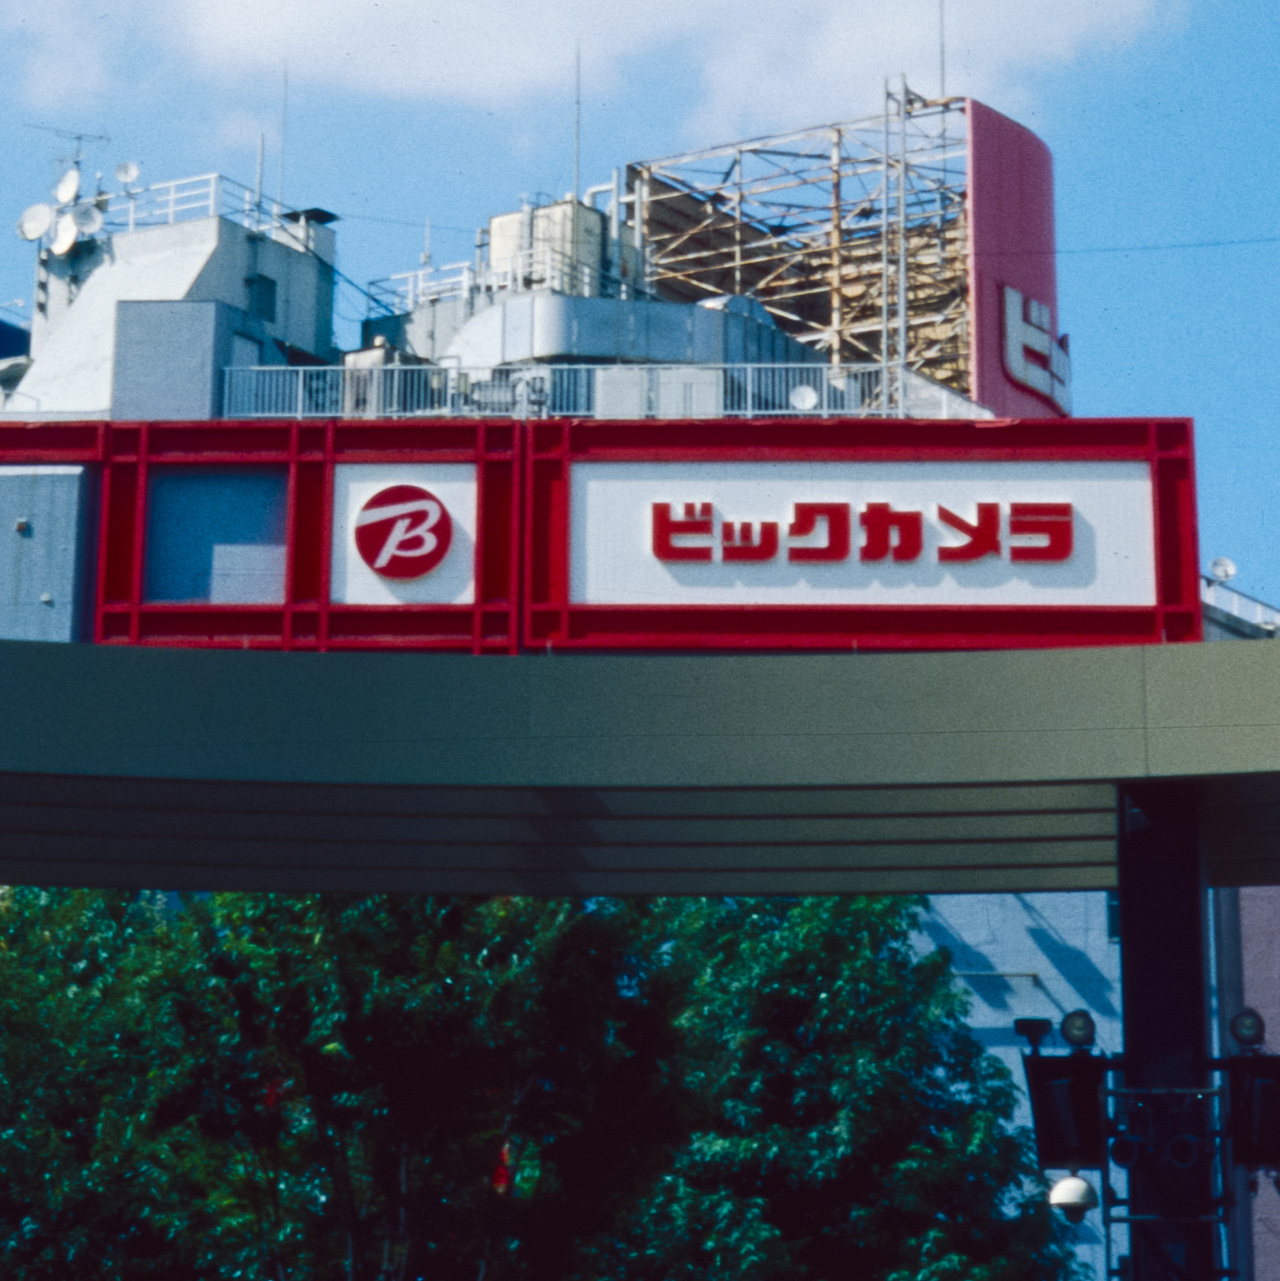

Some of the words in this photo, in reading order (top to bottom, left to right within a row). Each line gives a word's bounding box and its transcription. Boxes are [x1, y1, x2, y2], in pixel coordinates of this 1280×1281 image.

[650, 501, 1074, 565] ビックカメラ
